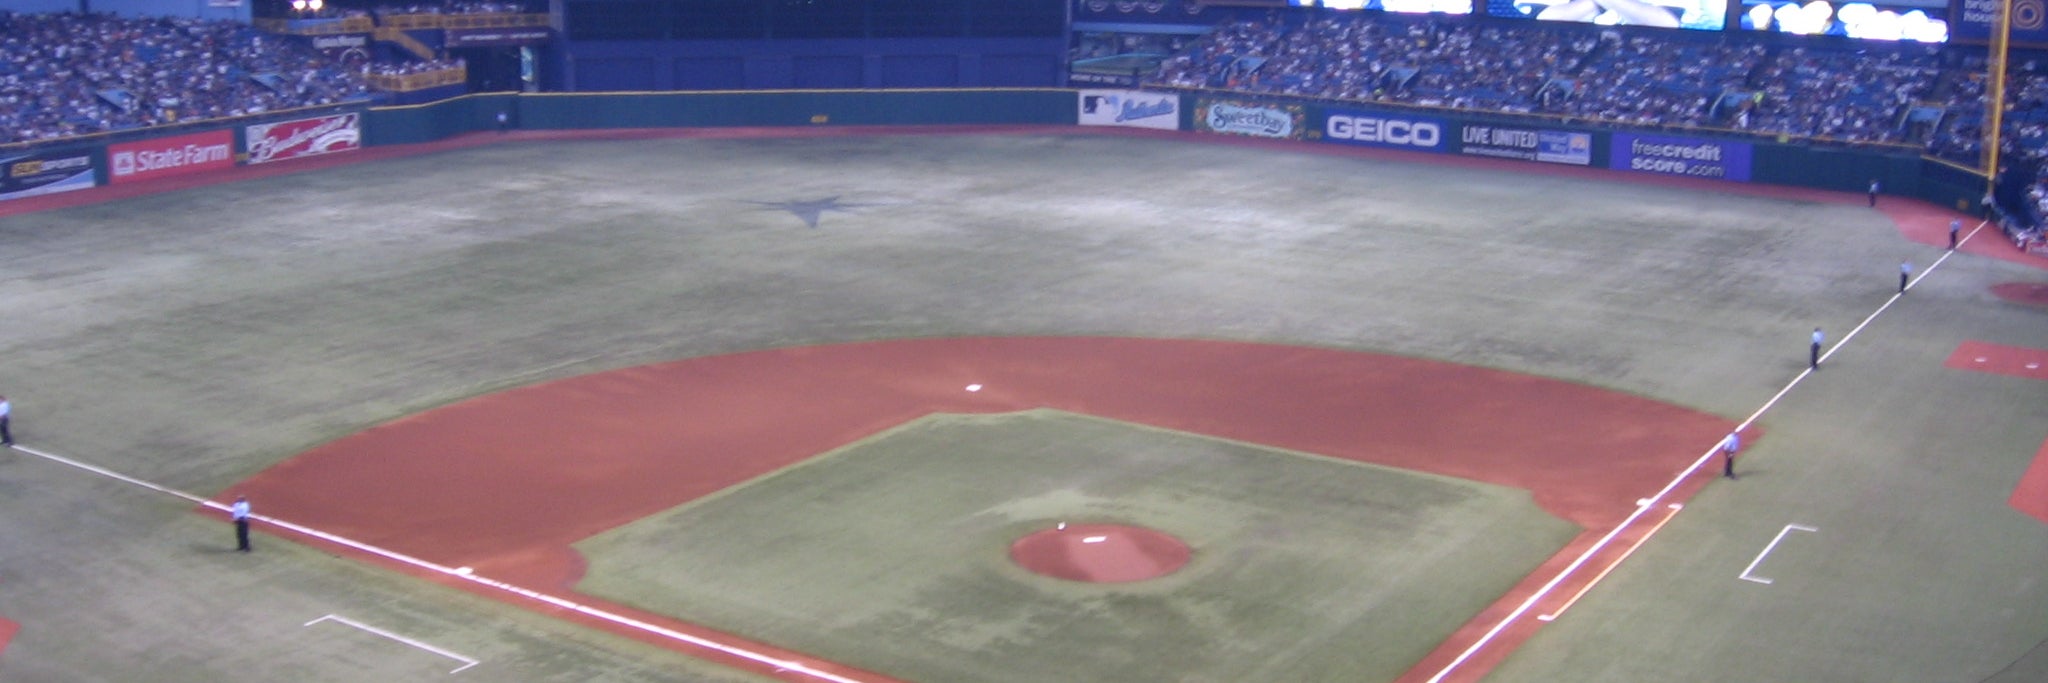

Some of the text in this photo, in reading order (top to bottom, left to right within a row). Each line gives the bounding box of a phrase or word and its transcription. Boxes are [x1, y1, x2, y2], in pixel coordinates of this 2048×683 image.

[1213, 105, 1286, 134] Sweetbay
[1326, 114, 1440, 147] GEICO
[1462, 125, 1538, 149] LIVE UNITED
[1632, 138, 1722, 162] freecredit
[1631, 156, 1725, 177] score.com
